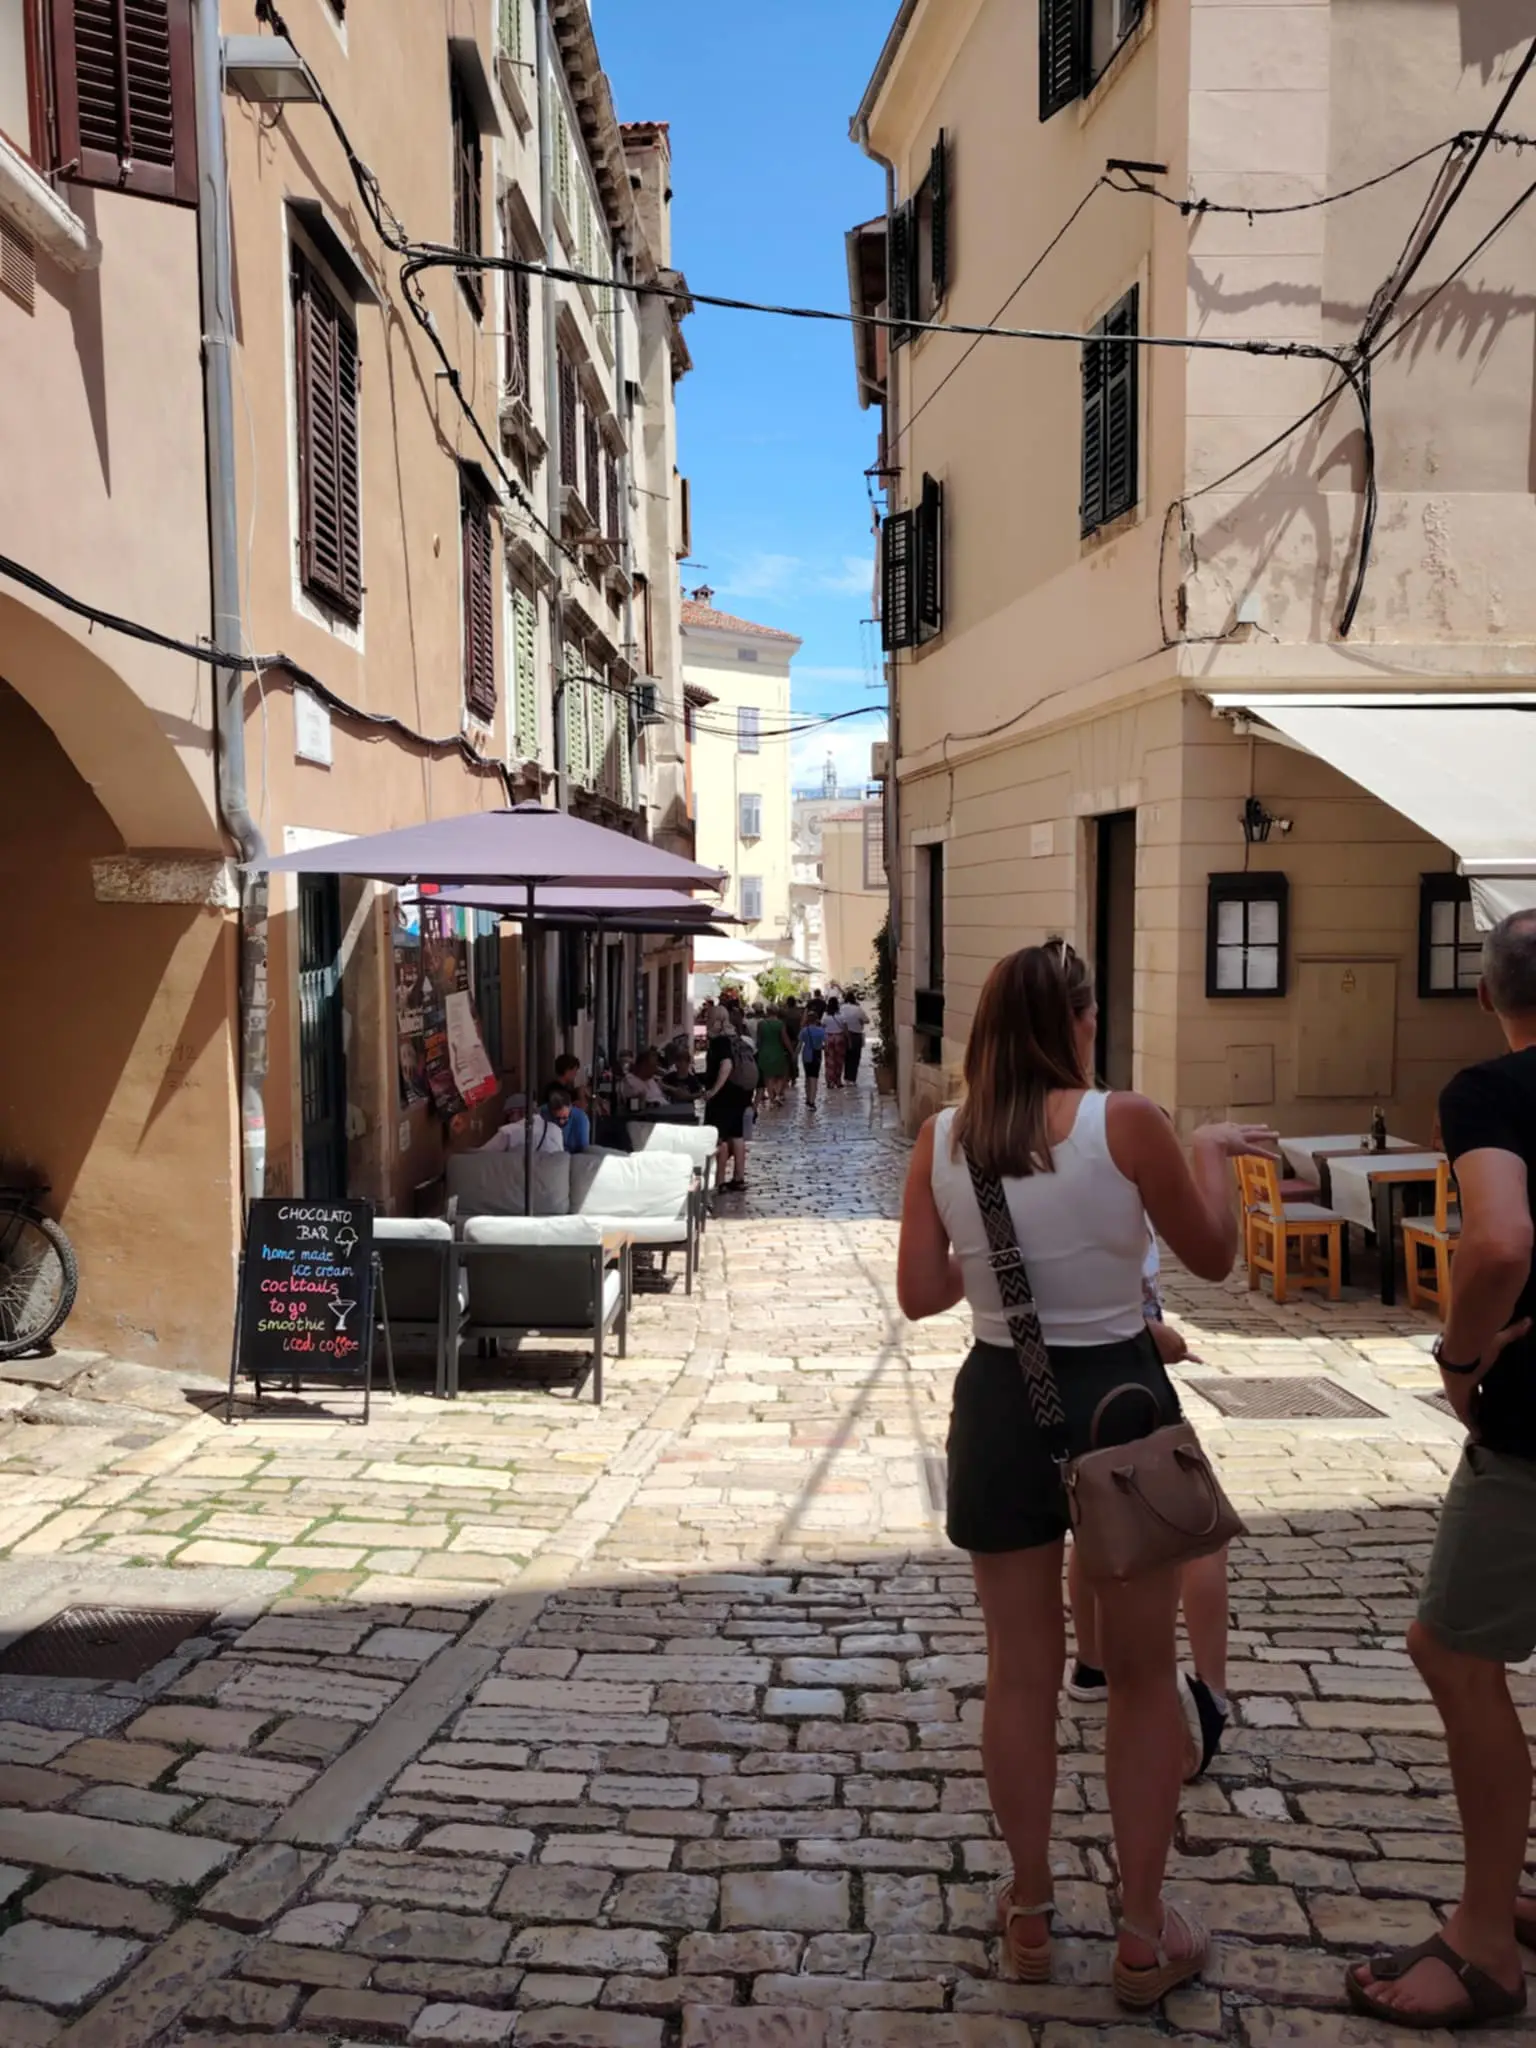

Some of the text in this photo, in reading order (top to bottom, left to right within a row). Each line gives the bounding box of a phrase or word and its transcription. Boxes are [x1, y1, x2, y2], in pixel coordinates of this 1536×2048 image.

[278, 1206, 352, 1223] CHOCOLATO
[296, 1225, 329, 1240] BAR
[262, 1244, 334, 1261] home made
[292, 1264, 354, 1276] ice cream
[260, 1276, 339, 1295] cocktails
[269, 1298, 307, 1320] to go
[257, 1317, 325, 1331] smoothie
[283, 1332, 359, 1357] iced coffee
